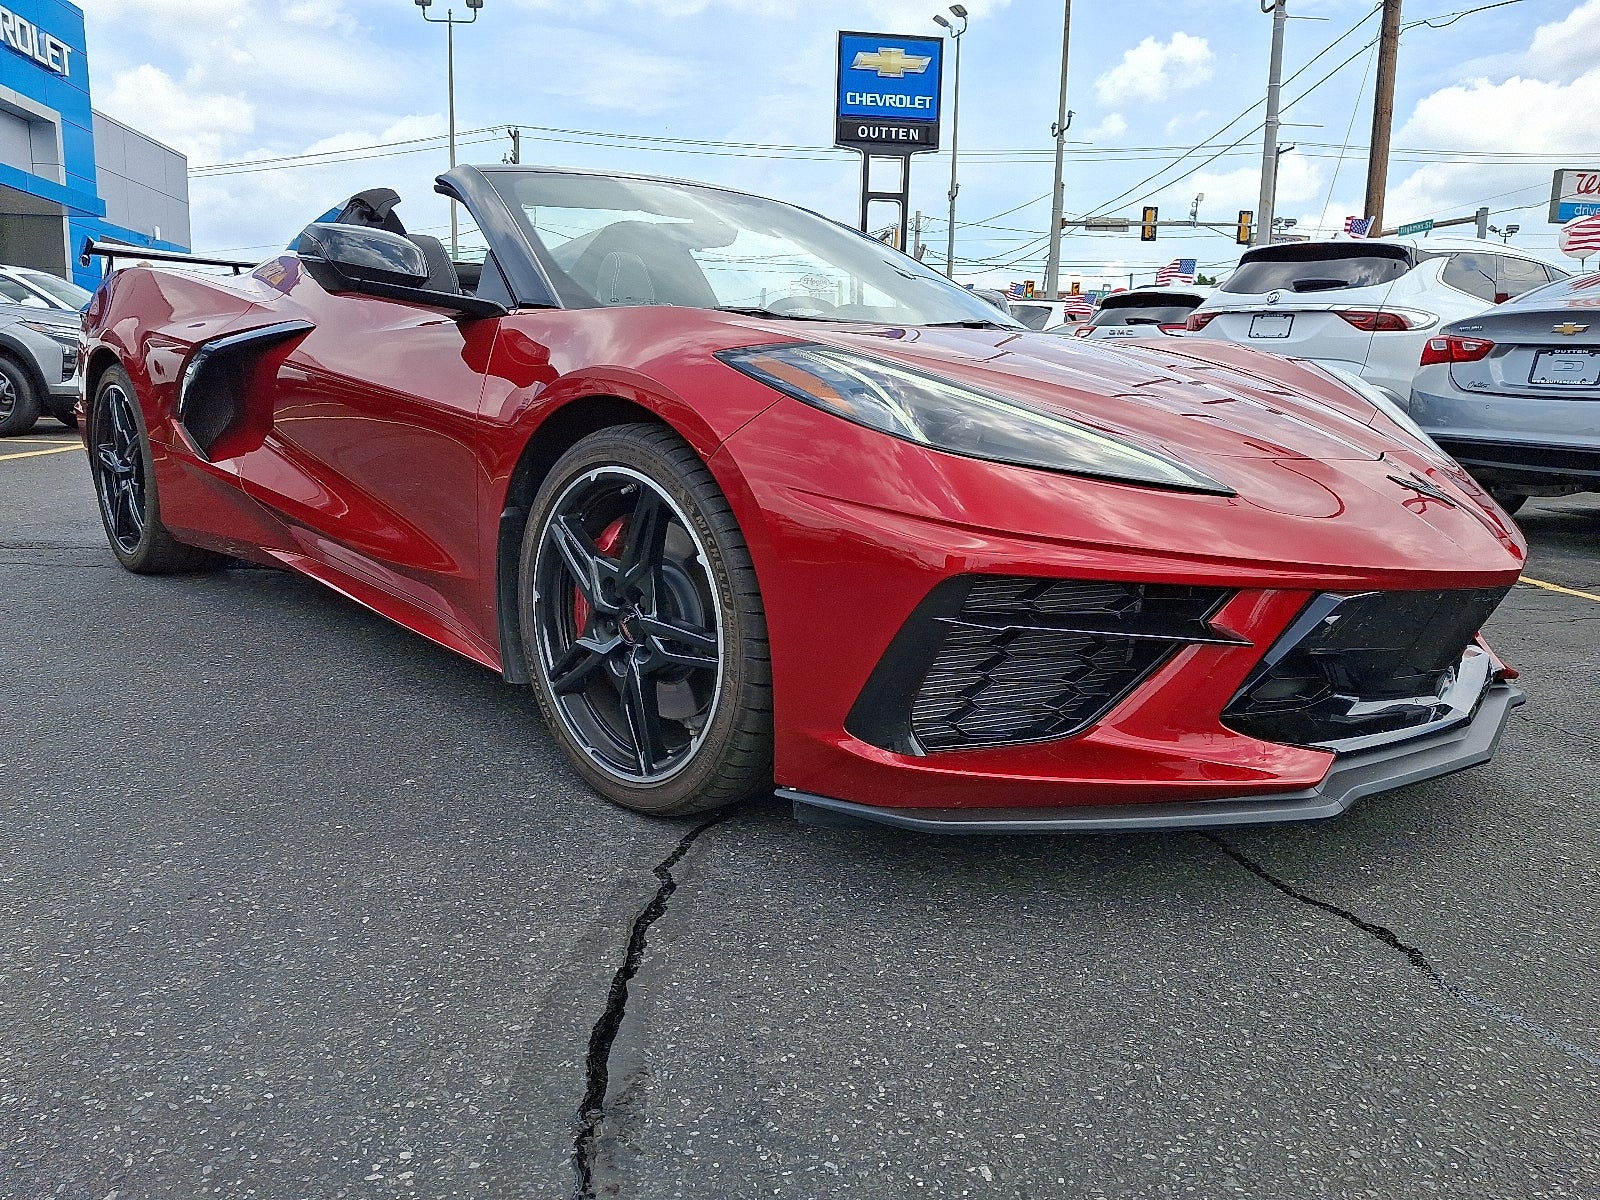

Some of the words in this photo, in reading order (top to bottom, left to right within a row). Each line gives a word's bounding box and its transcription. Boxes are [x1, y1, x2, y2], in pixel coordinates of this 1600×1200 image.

[846, 92, 933, 109] CHEVROLET
[857, 125, 919, 140] OUTTEN
[695, 514, 732, 604] MICHELIN
